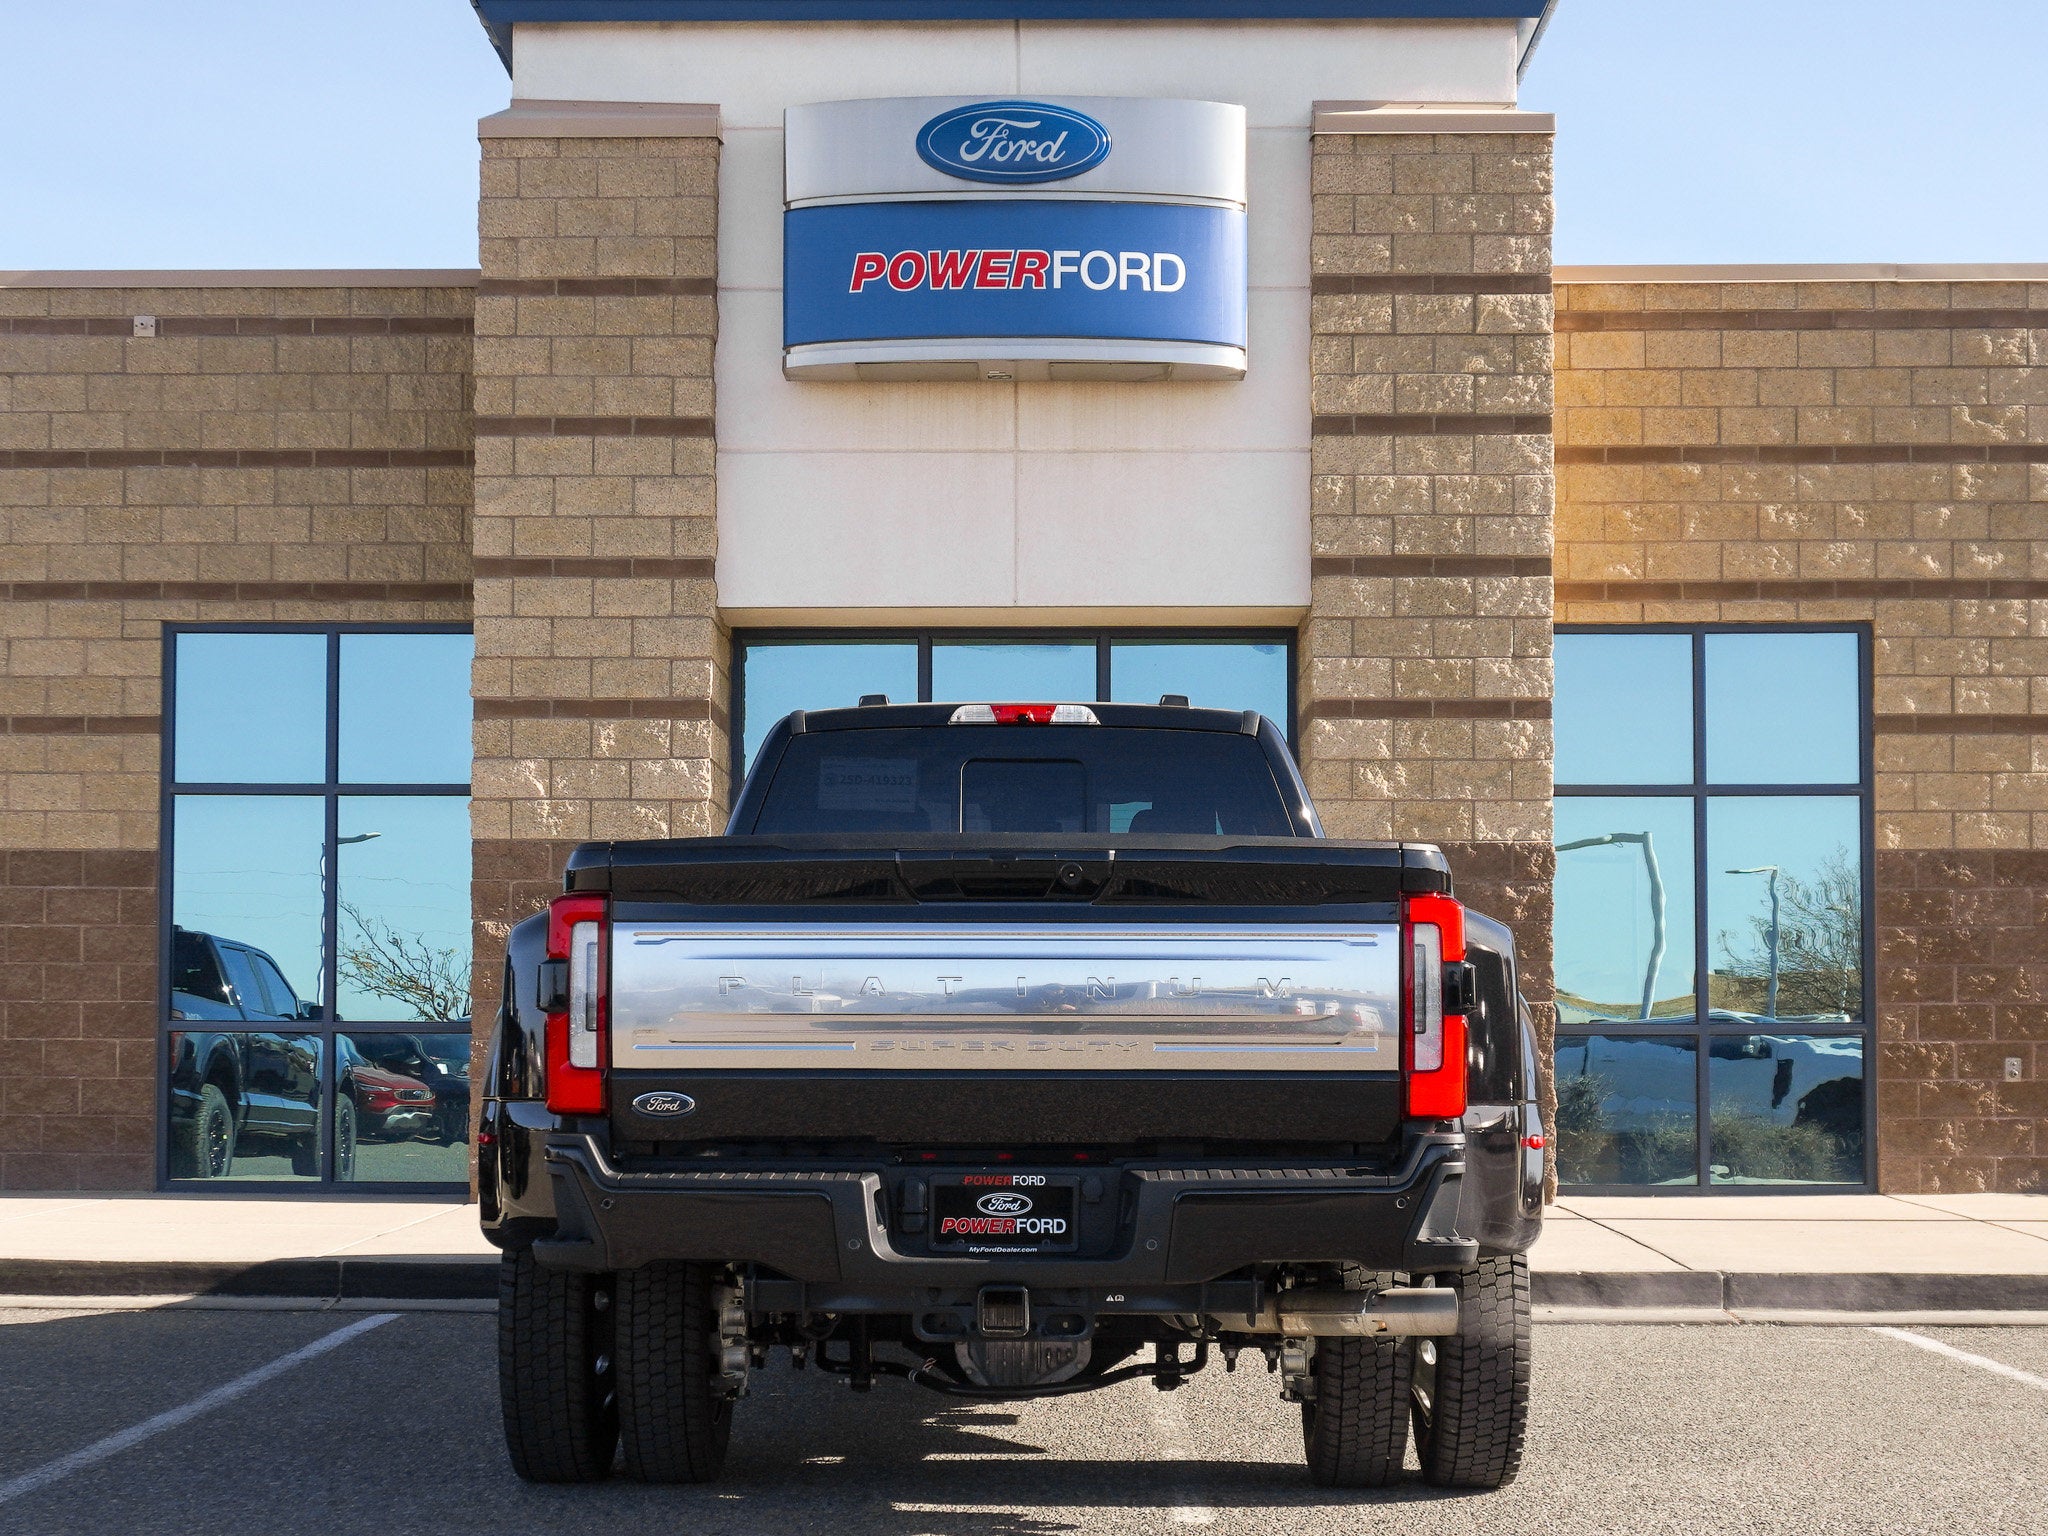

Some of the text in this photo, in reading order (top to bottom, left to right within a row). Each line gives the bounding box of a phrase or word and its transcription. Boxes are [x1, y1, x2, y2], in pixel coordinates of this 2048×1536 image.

[960, 117, 1068, 163] Ford
[848, 249, 1187, 293] POWERFORD
[718, 976, 1292, 997] PLATINUM
[870, 1040, 1140, 1052] SUPER DUTY
[645, 1095, 680, 1112] Ford
[963, 1175, 1046, 1186] POWERFORD
[987, 1196, 1021, 1211] Ford
[941, 1217, 1067, 1234] POWERFORD
[968, 1246, 1038, 1254] MyFordDealer.com
